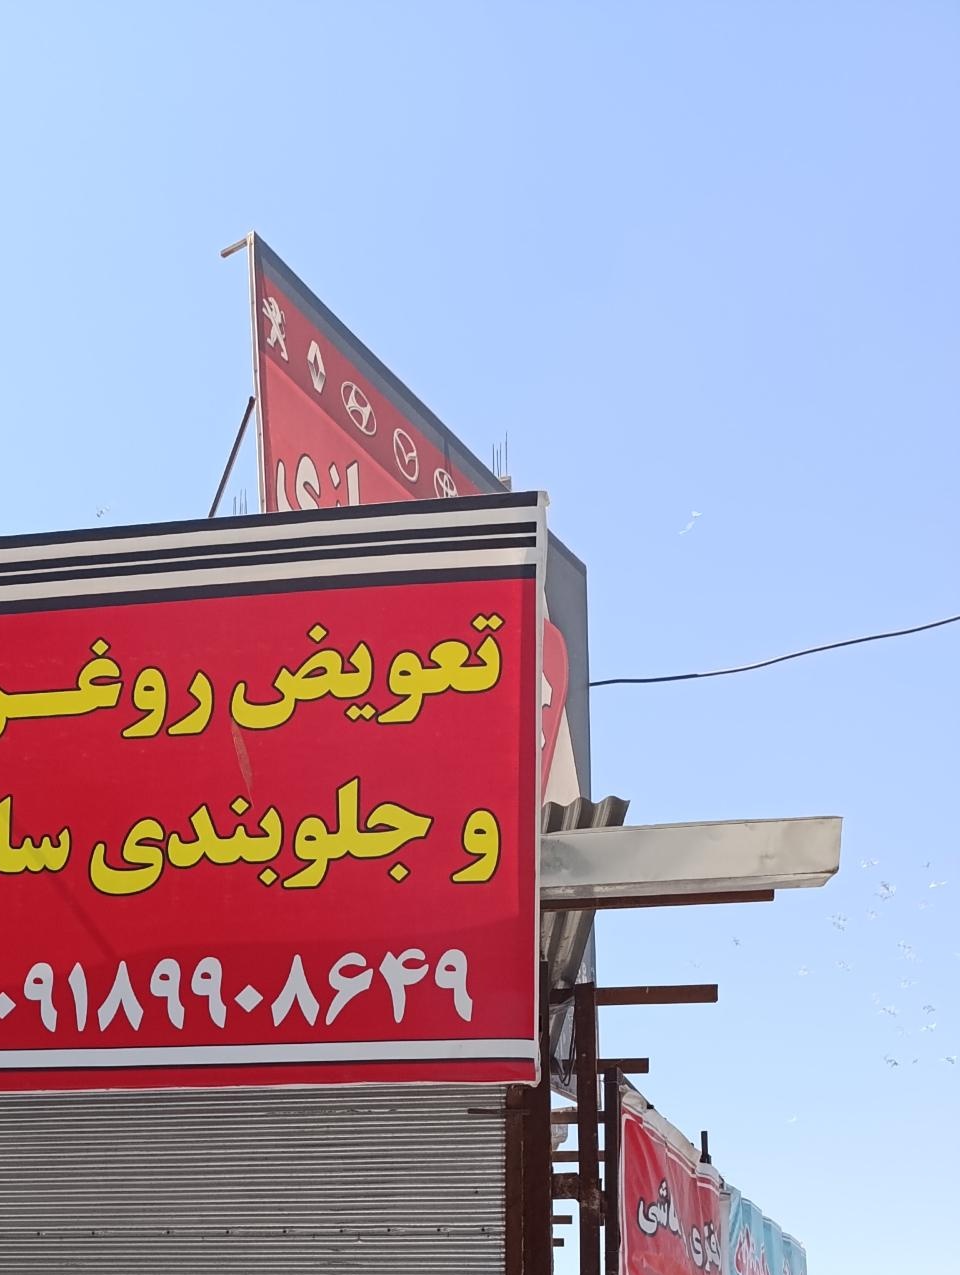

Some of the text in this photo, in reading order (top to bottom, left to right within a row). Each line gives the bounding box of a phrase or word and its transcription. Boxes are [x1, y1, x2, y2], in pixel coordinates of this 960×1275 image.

[231, 613, 504, 731] تعویض
[90, 778, 433, 896] جلوبندی
[451, 808, 501, 883] و
